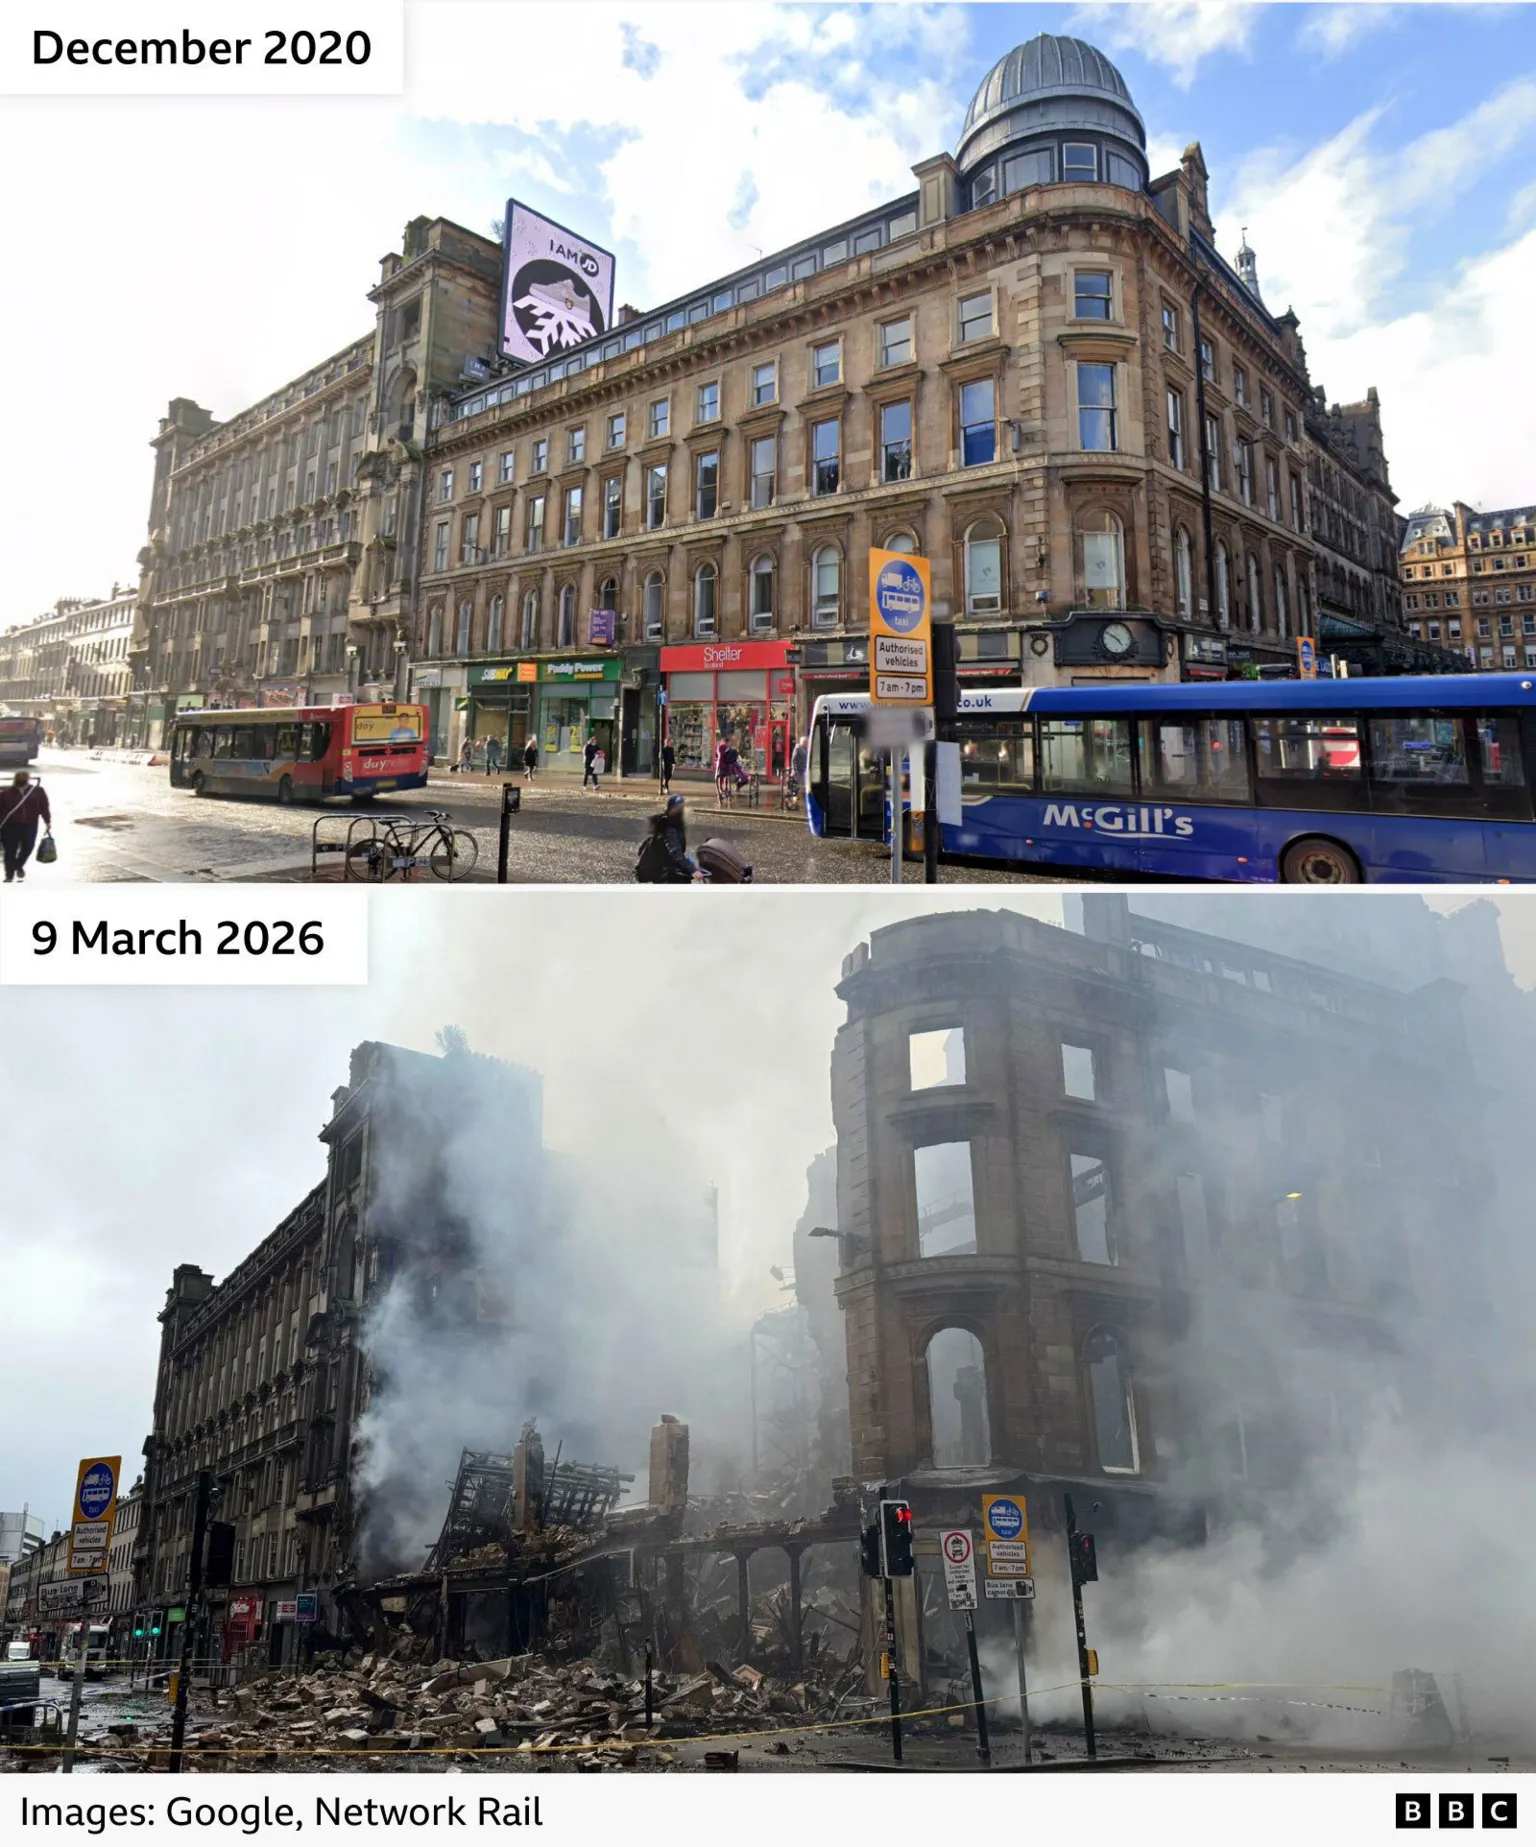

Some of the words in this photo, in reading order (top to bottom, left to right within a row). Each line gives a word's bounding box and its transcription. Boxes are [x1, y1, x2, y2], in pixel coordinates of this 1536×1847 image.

[550, 239, 554, 251] I
[556, 244, 578, 264] AM
[580, 256, 598, 274] JD
[894, 616, 909, 627] taxi
[703, 645, 743, 662] Shelter
[879, 642, 924, 656] Authorised
[885, 656, 919, 668] vehicles
[482, 667, 513, 681] SUBWAY
[547, 663, 574, 675] Paddy
[574, 662, 605, 673] Power
[1043, 803, 1194, 836] McGill's
[89, 1505, 100, 1513] taxi
[76, 1524, 107, 1534] Authorised
[1001, 1528, 1013, 1536] taxi
[79, 1536, 102, 1544] vehicles
[992, 1543, 1024, 1551] Authorised
[60, 1584, 79, 1594] lane
